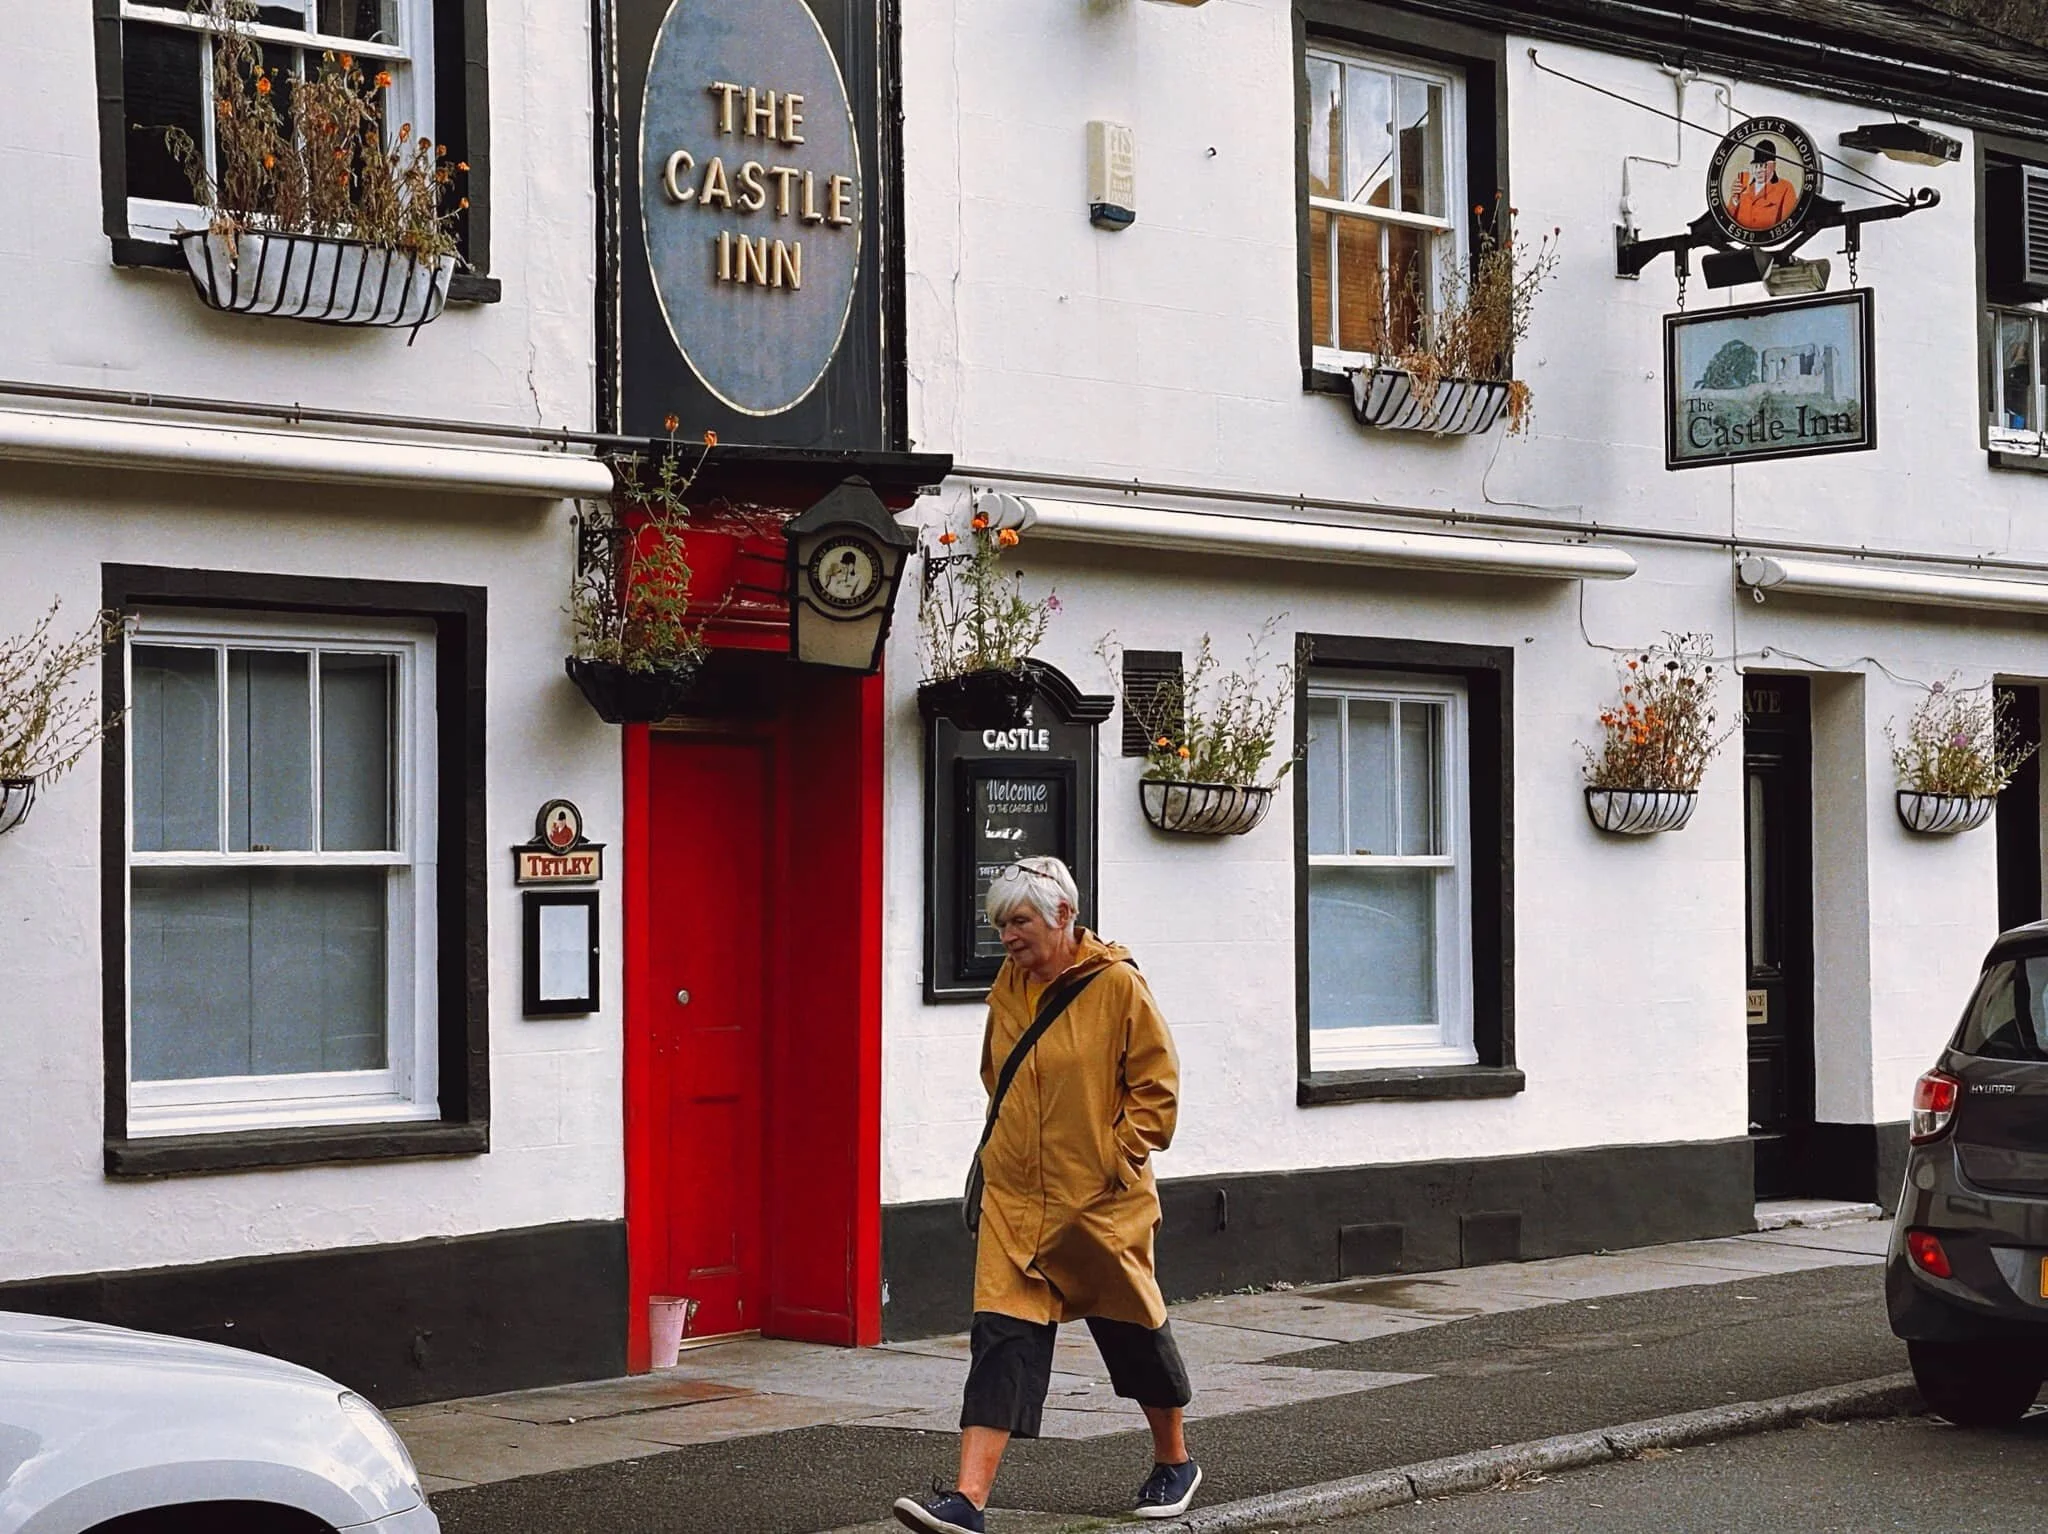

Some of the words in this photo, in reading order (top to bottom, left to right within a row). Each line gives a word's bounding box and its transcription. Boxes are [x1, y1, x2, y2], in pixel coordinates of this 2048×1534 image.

[711, 81, 805, 144] THE
[664, 150, 853, 226] CASTLE
[1710, 180, 1720, 207] ONE
[1715, 149, 1727, 166] OF
[1769, 218, 1794, 239] 1822
[716, 230, 801, 290] INN
[1685, 398, 1714, 412] The
[1688, 408, 1785, 449] Castle
[1796, 405, 1852, 438] Inn
[982, 728, 1050, 751] CASTLE
[986, 779, 1047, 801] Welcome
[527, 855, 593, 877] TETLEY
[1971, 1084, 2016, 1095] HYUNDAI
